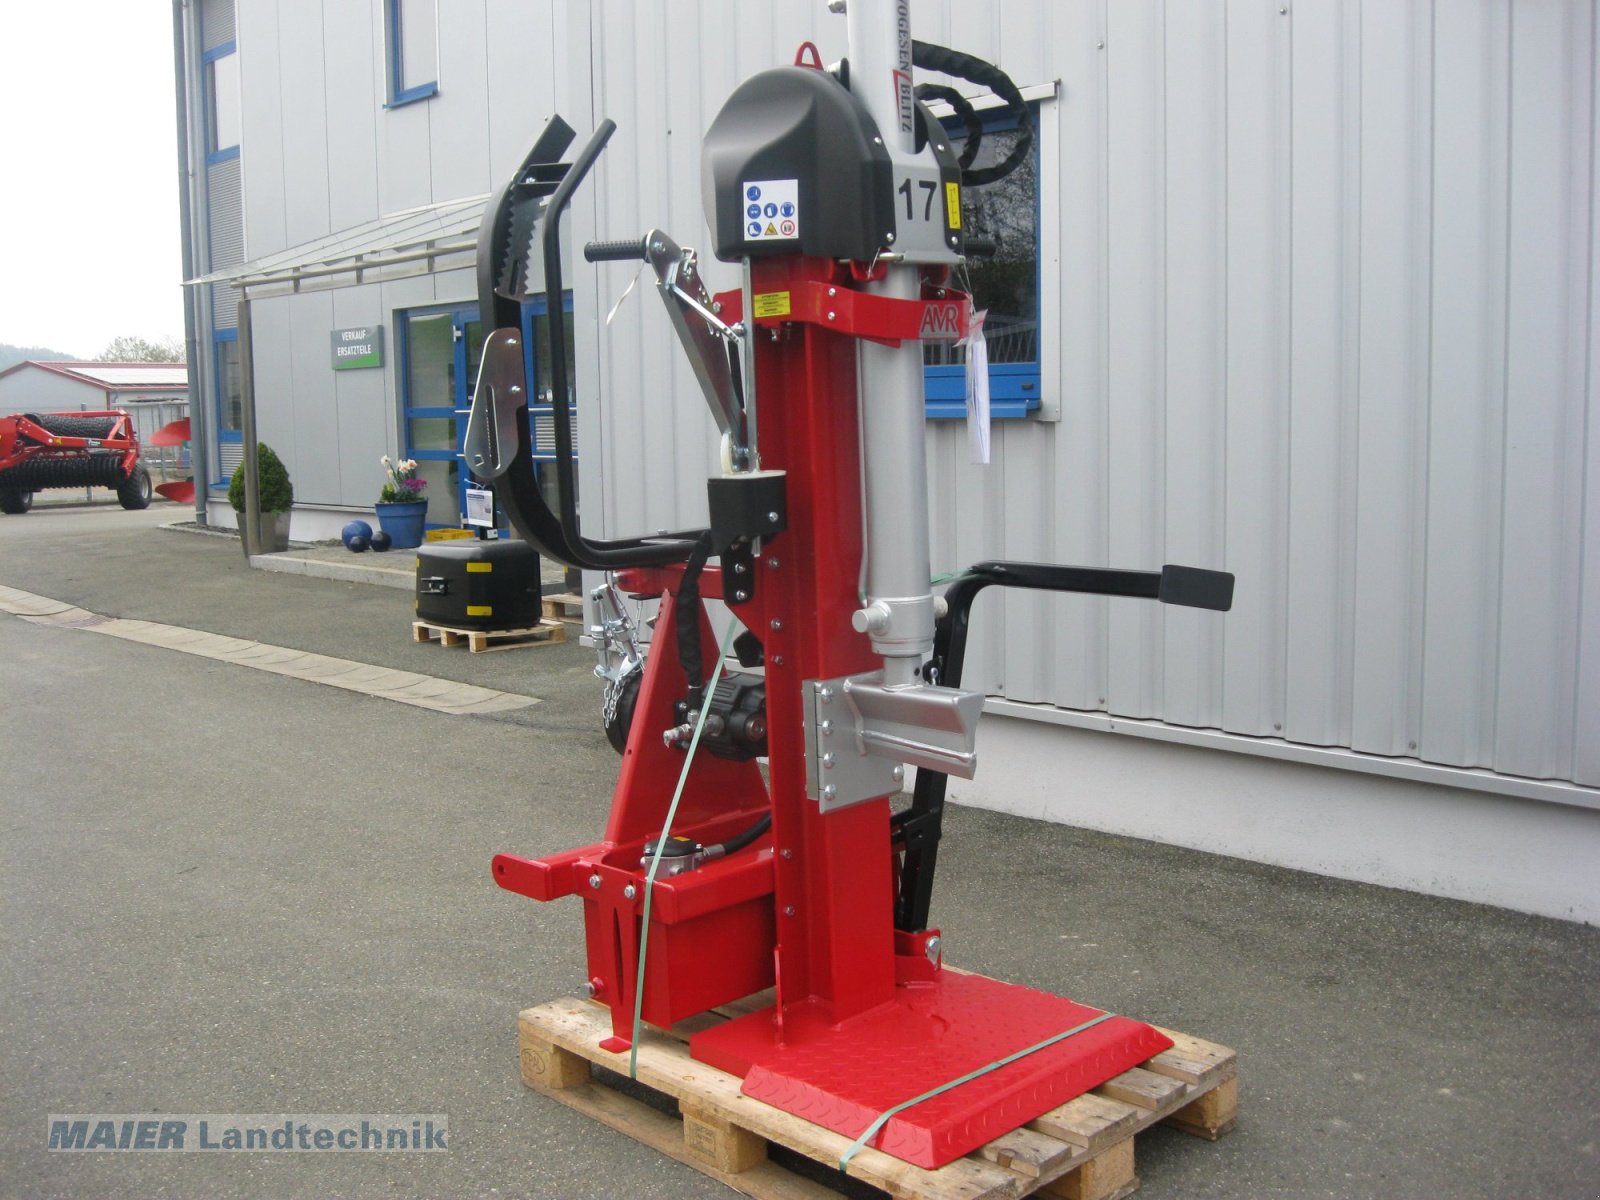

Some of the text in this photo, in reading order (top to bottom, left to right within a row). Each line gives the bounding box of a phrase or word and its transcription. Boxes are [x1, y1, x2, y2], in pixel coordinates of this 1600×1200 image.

[901, 82, 913, 133] BLITZ
[898, 178, 937, 221] 17
[920, 304, 958, 334] AMR
[337, 344, 372, 356] ERSATZTEILE
[341, 329, 366, 341] VERKAUF
